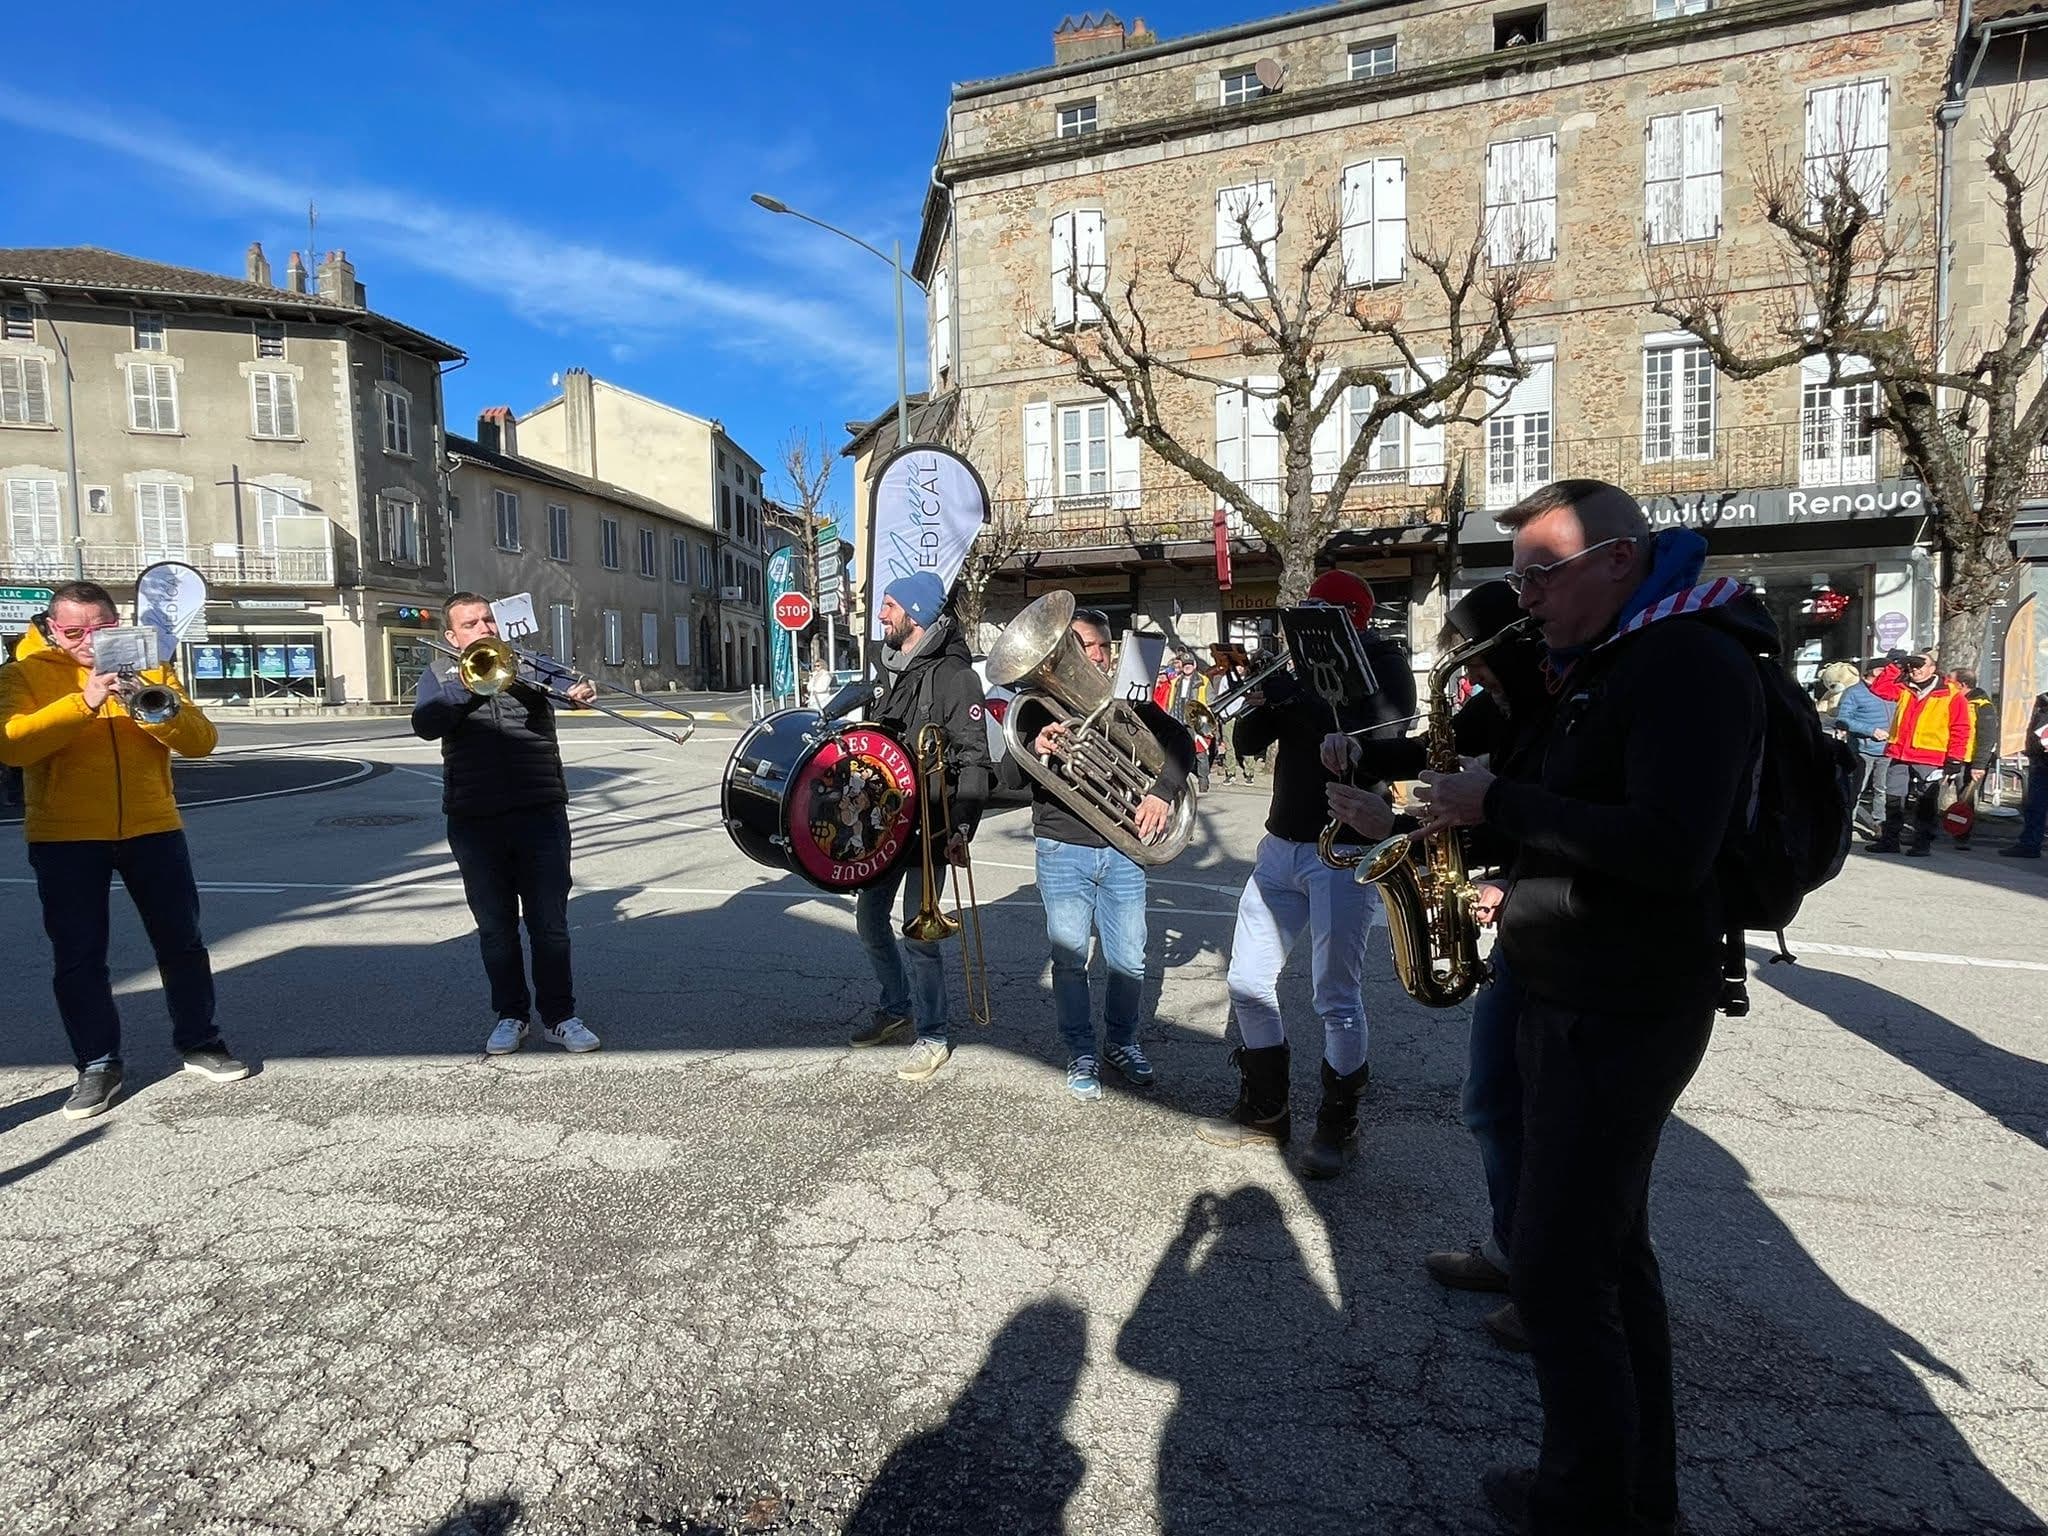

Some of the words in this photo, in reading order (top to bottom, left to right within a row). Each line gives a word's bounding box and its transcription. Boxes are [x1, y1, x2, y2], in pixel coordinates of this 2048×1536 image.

[778, 605, 808, 617] STOP
[836, 736, 869, 757] LES
[879, 742, 913, 799] TETES
[898, 813, 909, 825] A
[831, 840, 897, 880] CLIQUE
